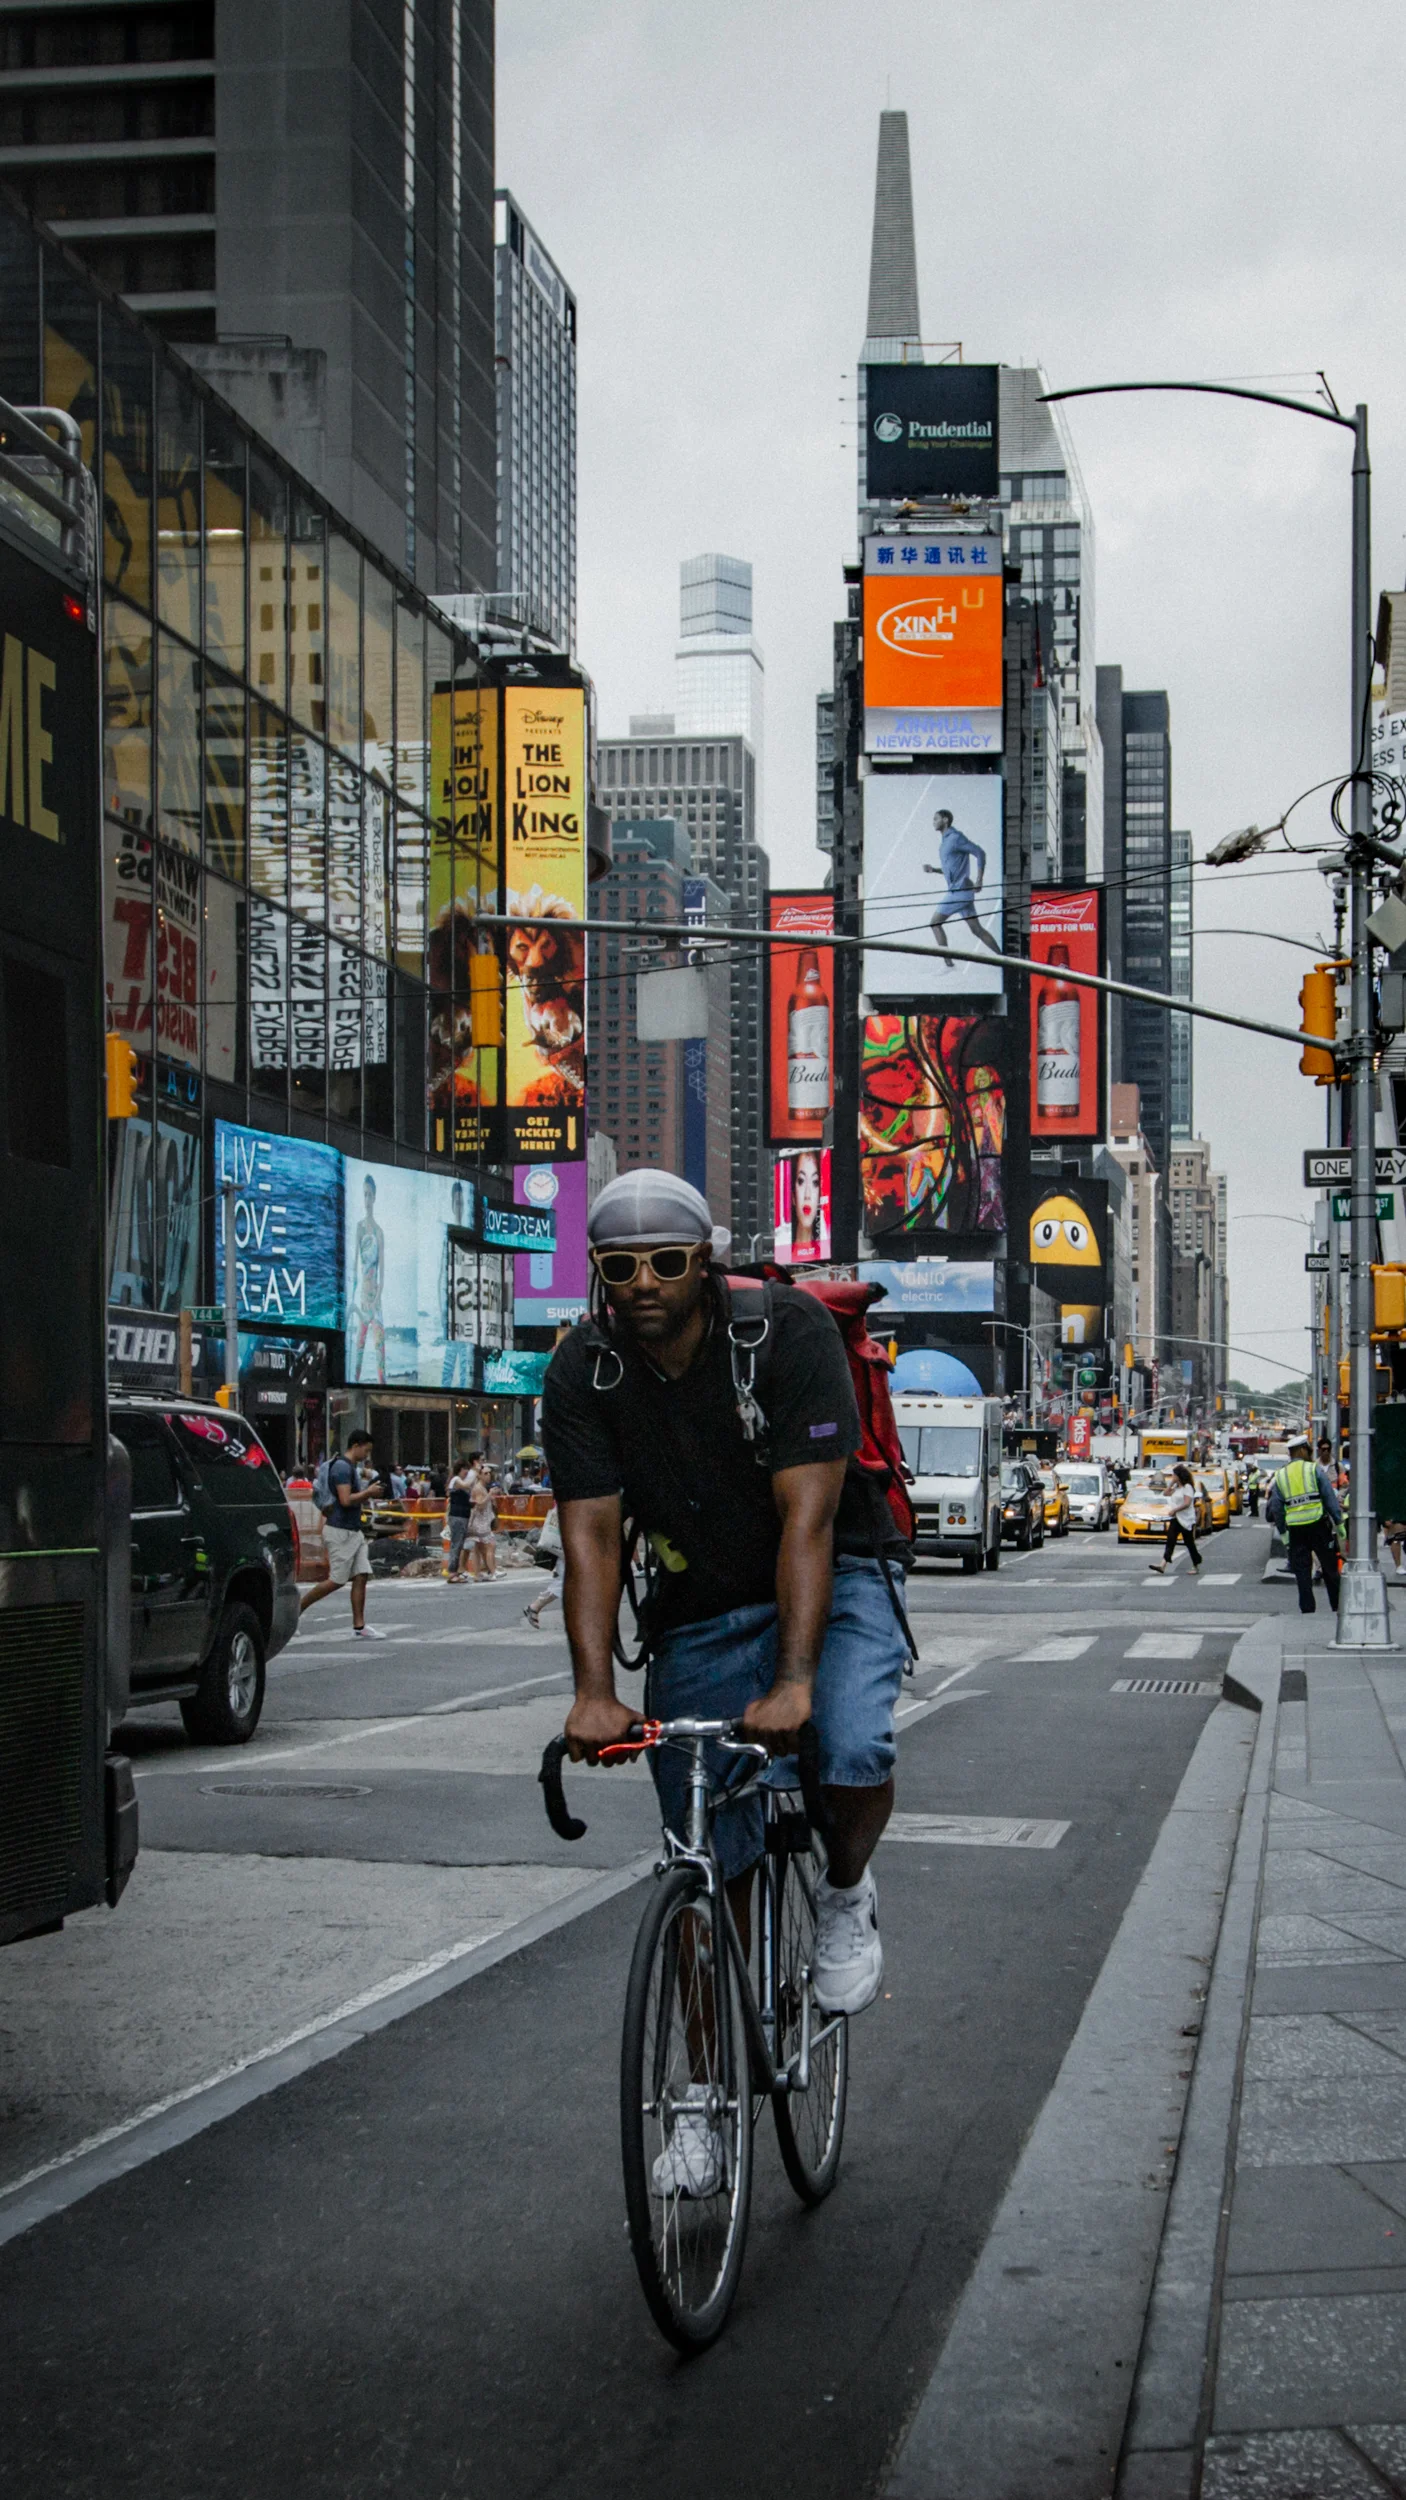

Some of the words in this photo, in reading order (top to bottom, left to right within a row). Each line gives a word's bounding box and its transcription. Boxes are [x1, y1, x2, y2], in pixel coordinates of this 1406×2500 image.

[908, 421, 992, 437] Prudential
[877, 546, 988, 565] 新华通讯社
[518, 708, 564, 727] Disney
[893, 716, 974, 733] XINHUA
[876, 734, 922, 748] NEWS
[925, 734, 993, 748] AGENCY
[523, 744, 561, 762] THE
[516, 767, 570, 799] LION
[512, 802, 579, 841] KING
[1063, 923, 1078, 932] FOR
[526, 1117, 550, 1126] GET
[514, 1128, 562, 1138] TICKETS
[520, 1141, 556, 1150] HERE!
[221, 1132, 272, 1191] LIVE
[1314, 1160, 1349, 1176] ONE
[512, 1214, 551, 1238] DREAM
[221, 1259, 305, 1316] REAM
[901, 1290, 943, 1302] electric
[199, 1309, 213, 1320] 44
[1074, 1418, 1088, 1444] tkts
